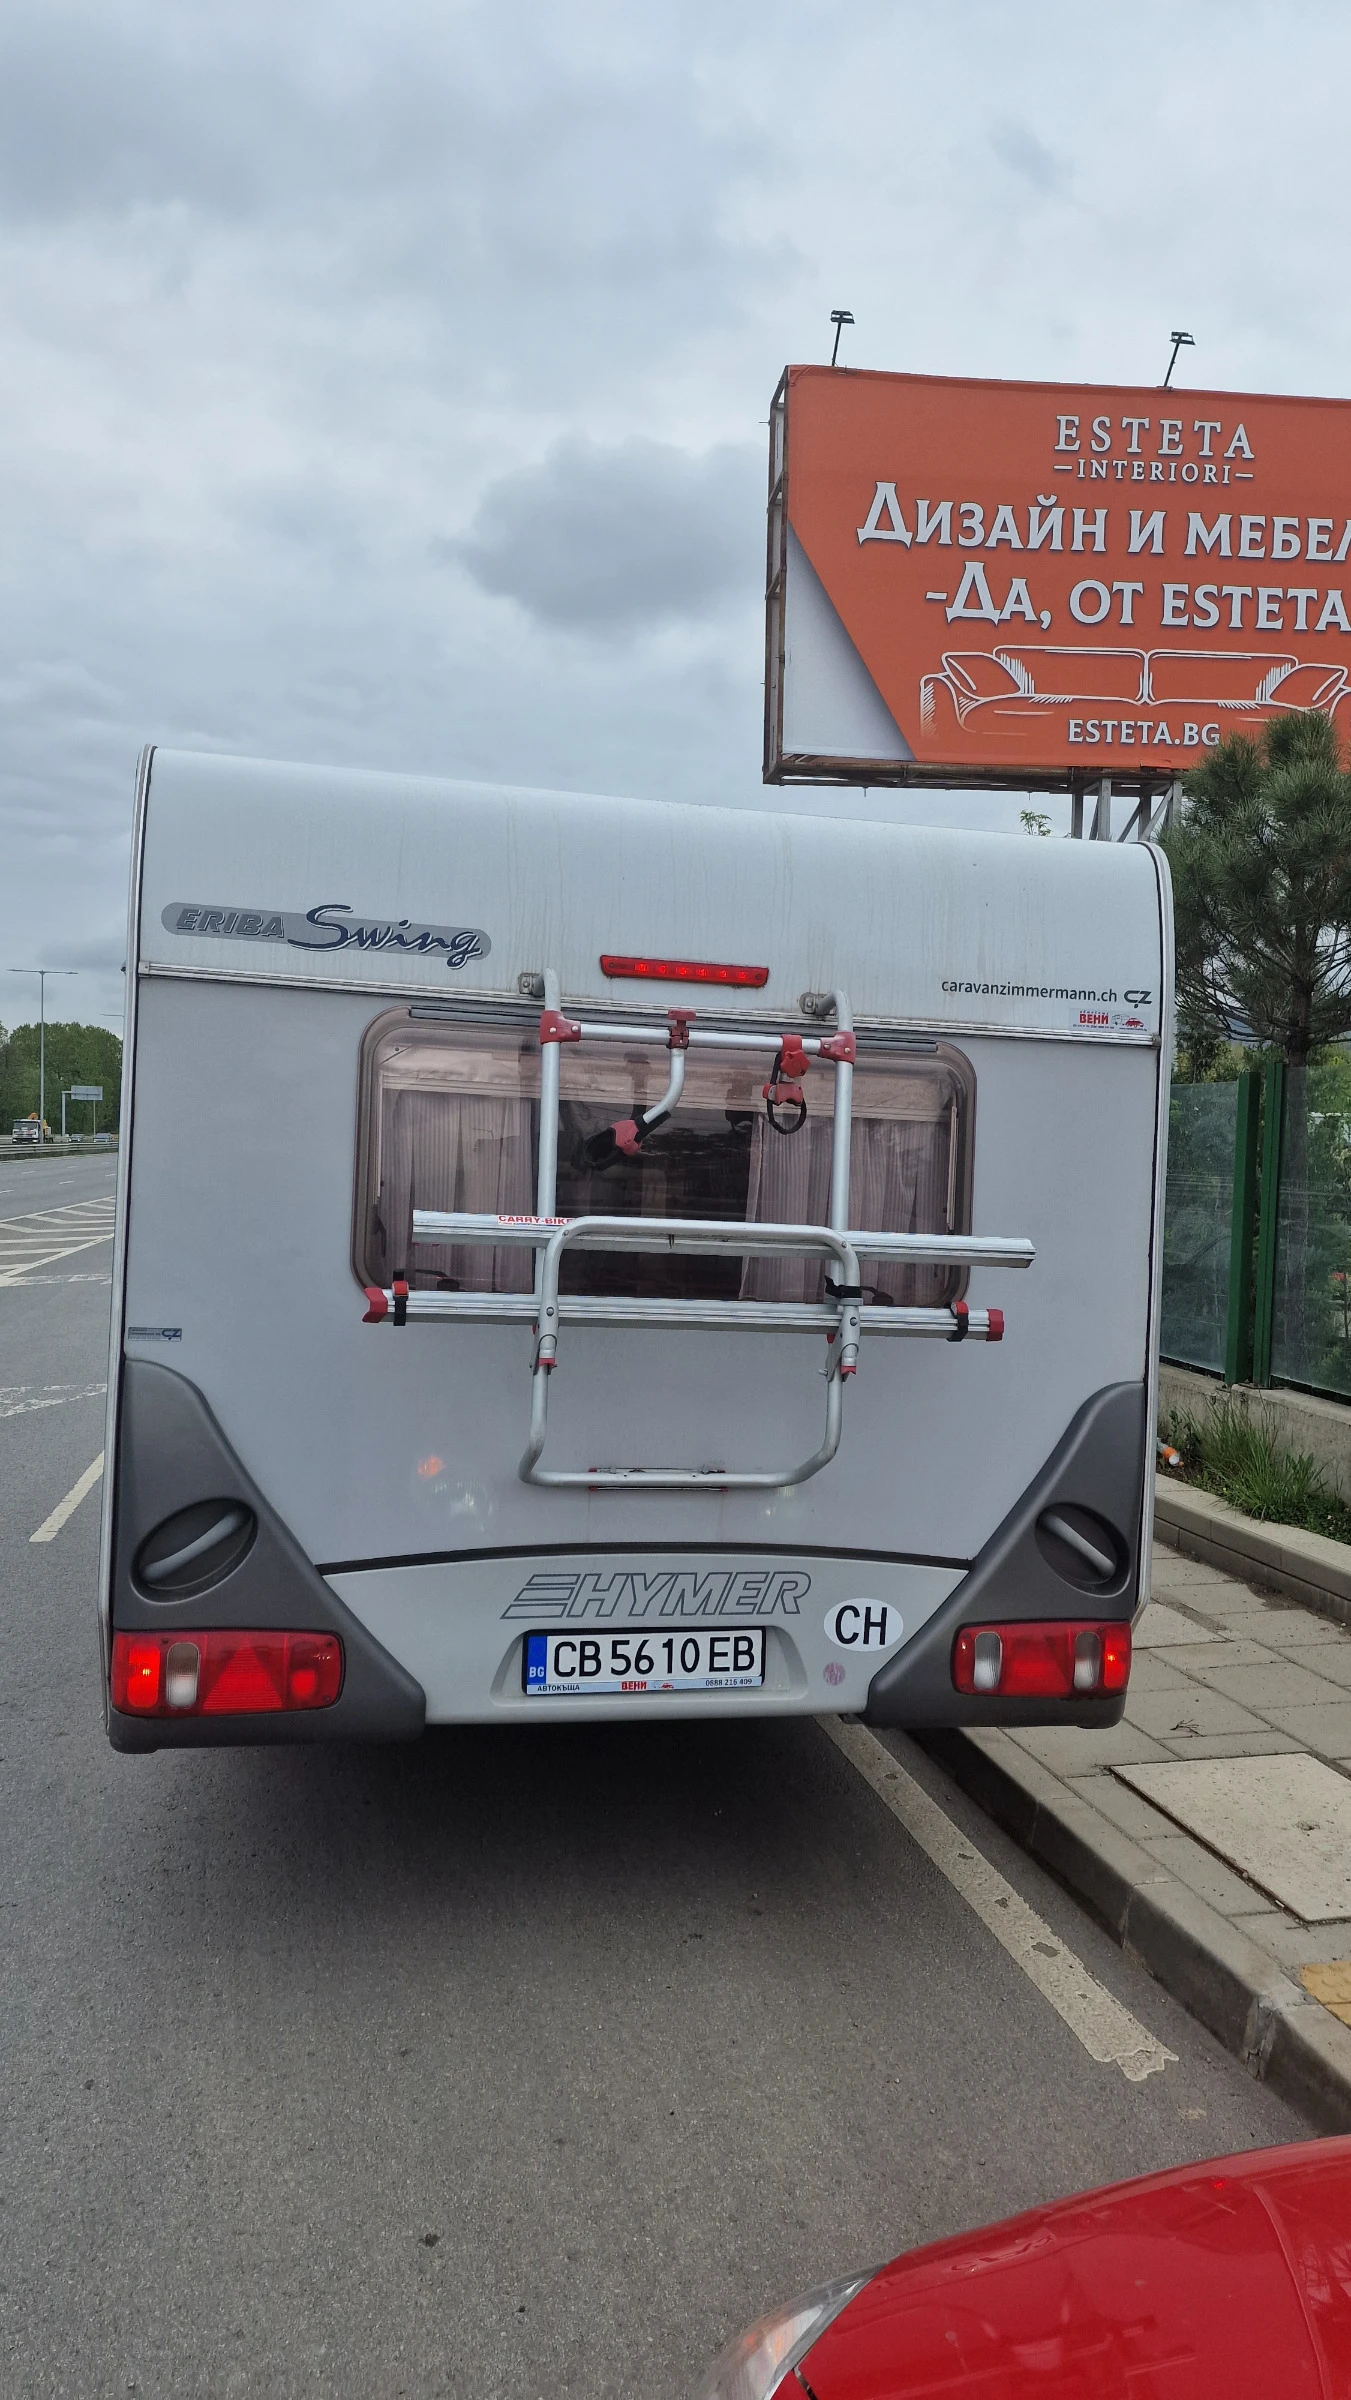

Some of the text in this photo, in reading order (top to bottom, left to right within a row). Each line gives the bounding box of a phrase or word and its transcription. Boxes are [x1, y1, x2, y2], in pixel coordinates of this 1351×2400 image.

[1054, 415, 1255, 459] ESTETA
[1077, 459, 1231, 484] INTERIORI
[857, 481, 1108, 553] ДИЗАЙН
[1127, 510, 1166, 554] И
[1068, 579, 1143, 625] ОТ
[1160, 583, 1351, 632] ESTETA
[1067, 718, 1221, 746] ESTETA.BG
[175, 904, 483, 970] ERIBA Swing
[941, 981, 1117, 1002] caravanzimmermann.ch
[567, 1571, 811, 1617] HYMER
[835, 1604, 887, 1646] CH
[529, 1666, 545, 1678] BG
[621, 1681, 648, 1691] ВЕНИ
